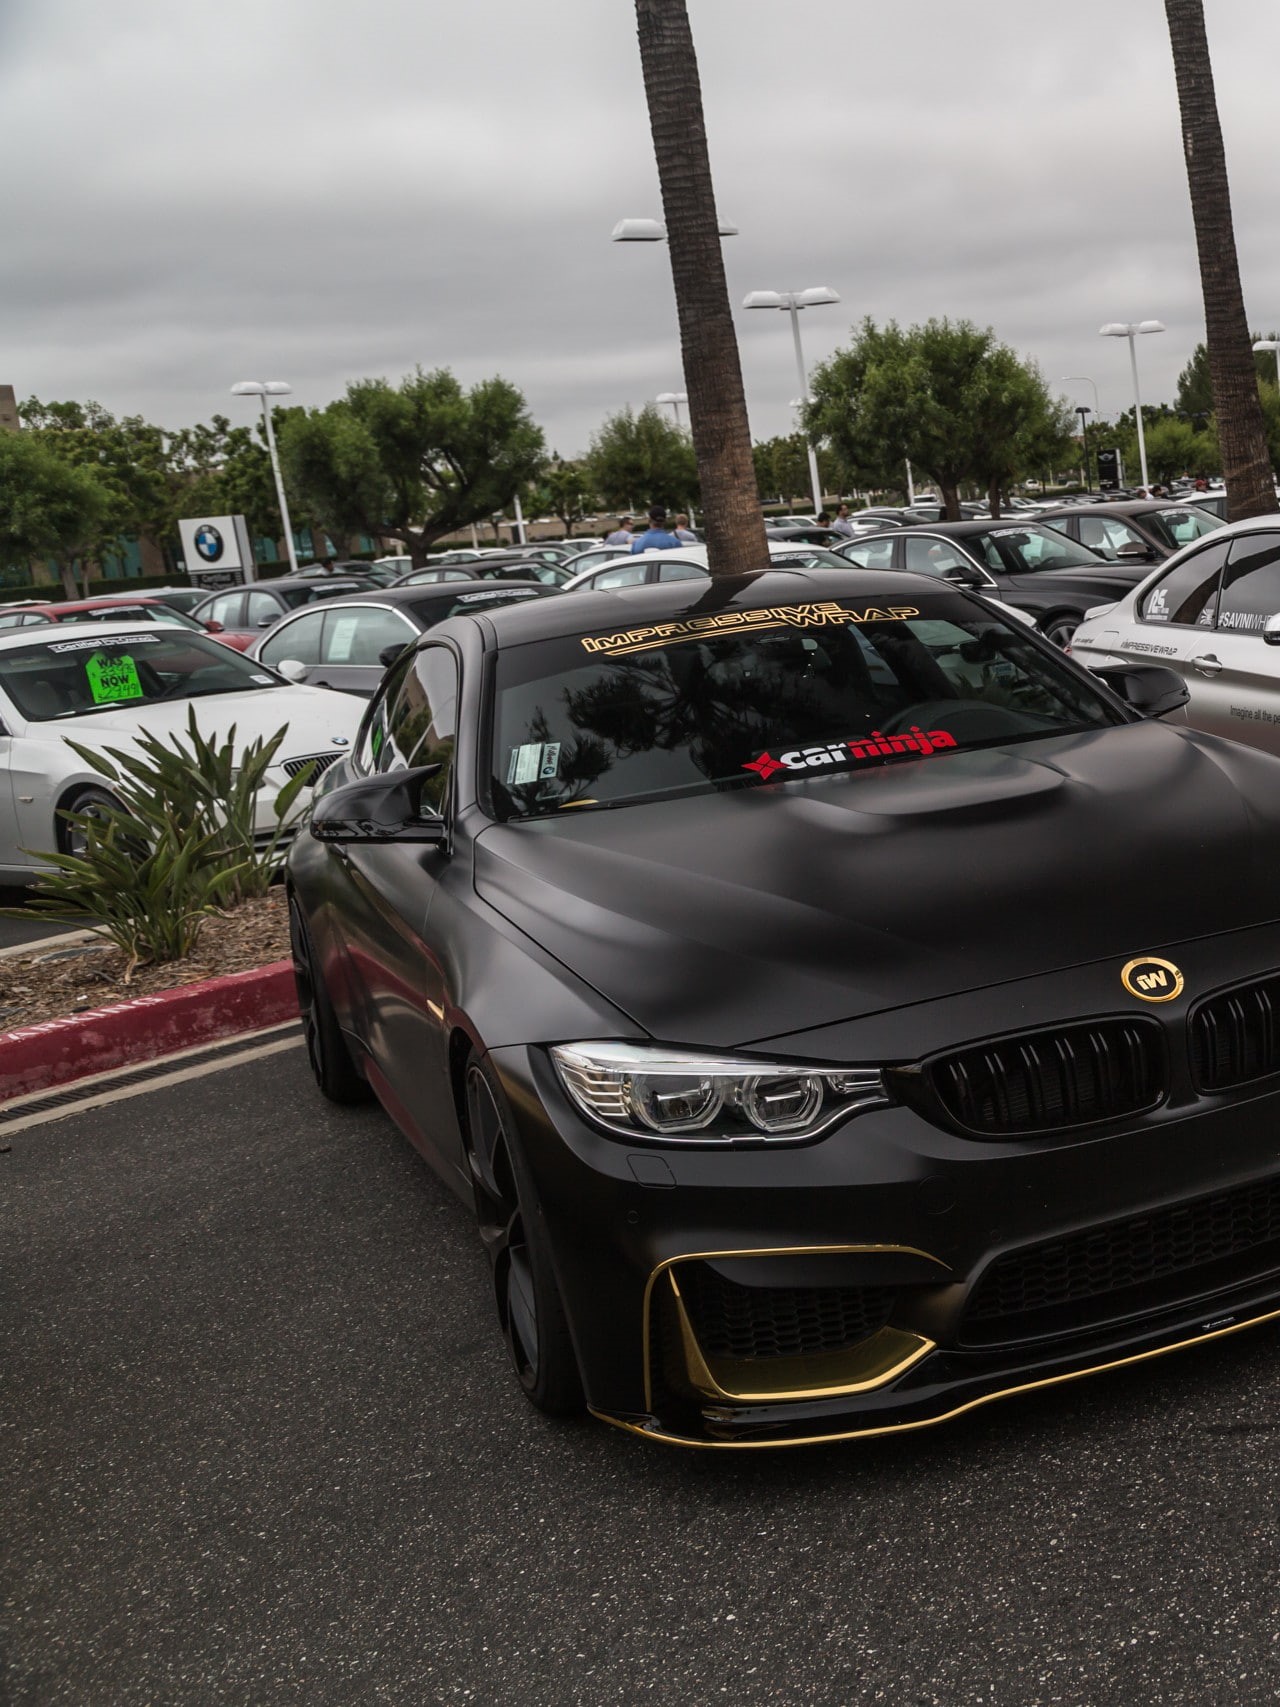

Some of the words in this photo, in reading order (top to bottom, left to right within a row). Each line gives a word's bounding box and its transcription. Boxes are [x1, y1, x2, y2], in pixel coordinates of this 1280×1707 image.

[781, 606, 920, 628] WRAP
[100, 674, 129, 688] NOW
[1230, 705, 1253, 720] Imagine
[1262, 711, 1272, 722] the
[780, 726, 958, 770] carninja
